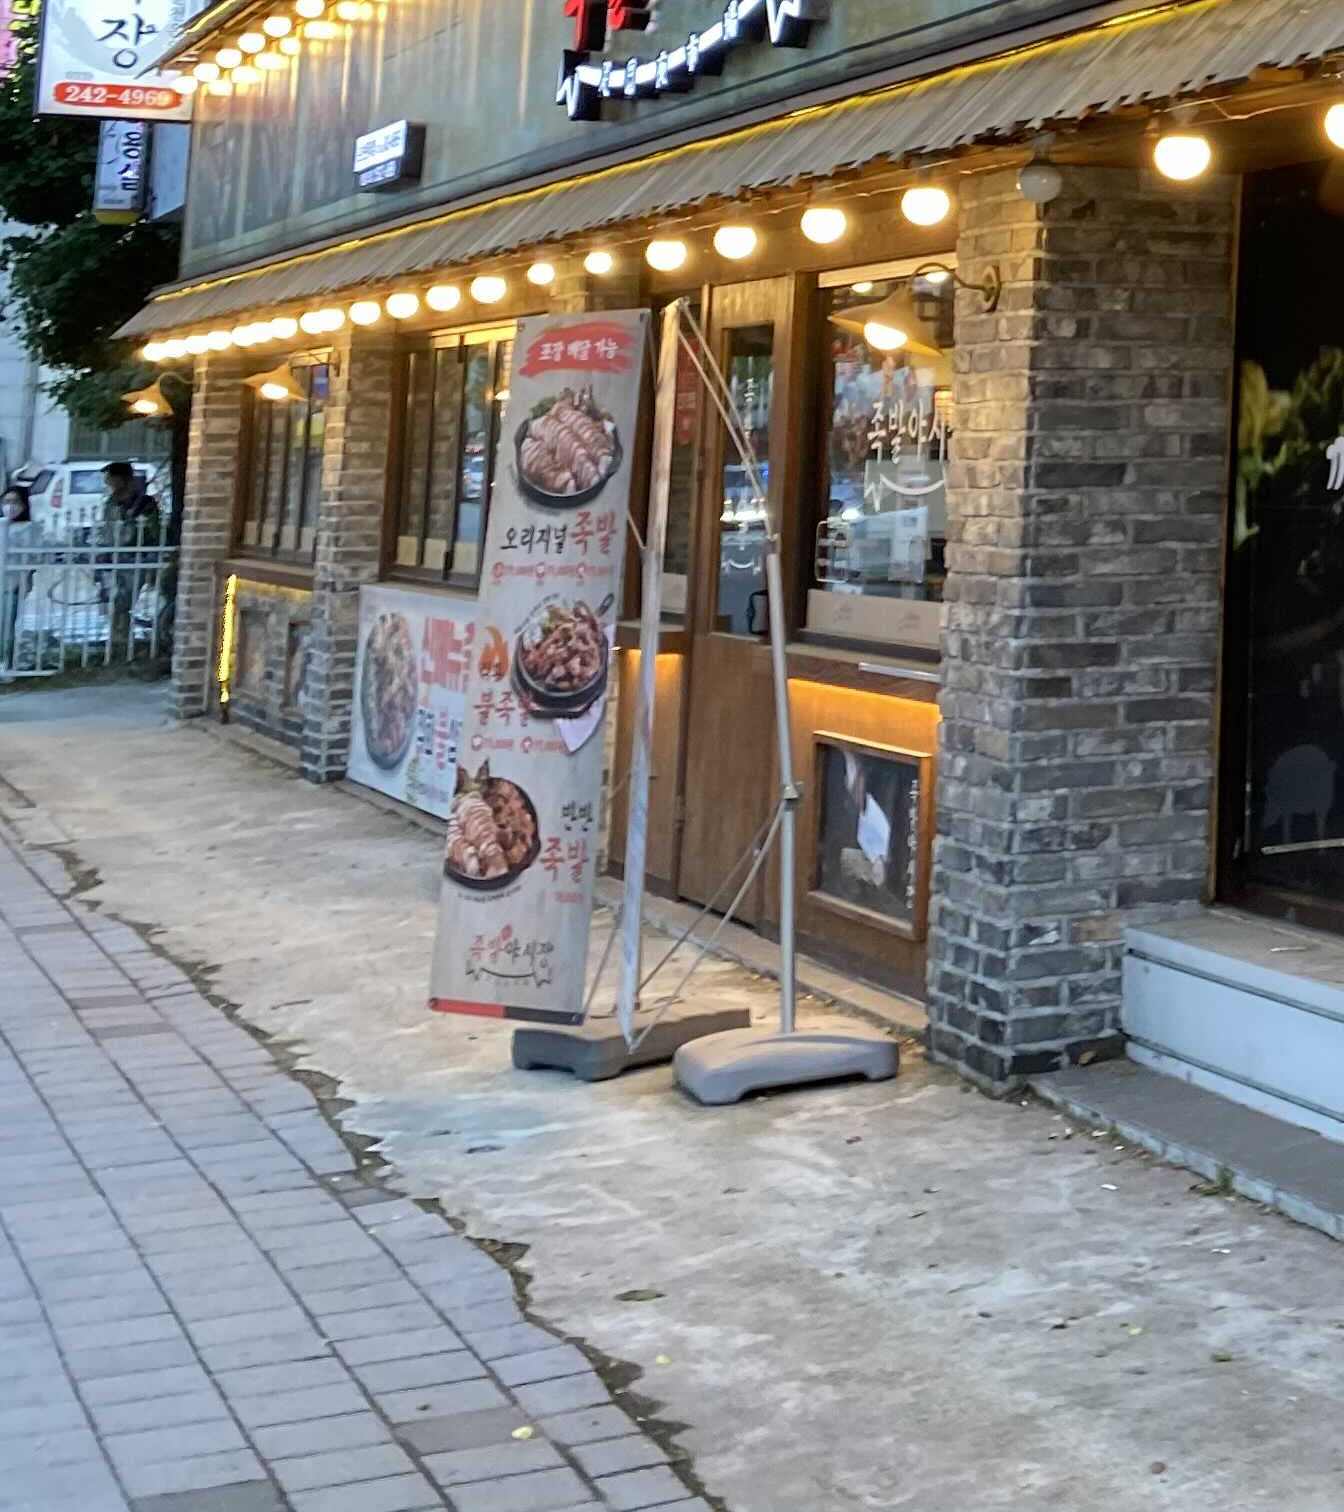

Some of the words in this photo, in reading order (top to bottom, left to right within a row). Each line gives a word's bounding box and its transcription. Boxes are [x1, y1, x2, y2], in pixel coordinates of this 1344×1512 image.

[866, 398, 954, 465] 족발야시
[500, 523, 568, 555] 오리지널
[570, 510, 617, 556] 족발
[562, 800, 593, 832] 반반
[540, 837, 590, 884] 족발
